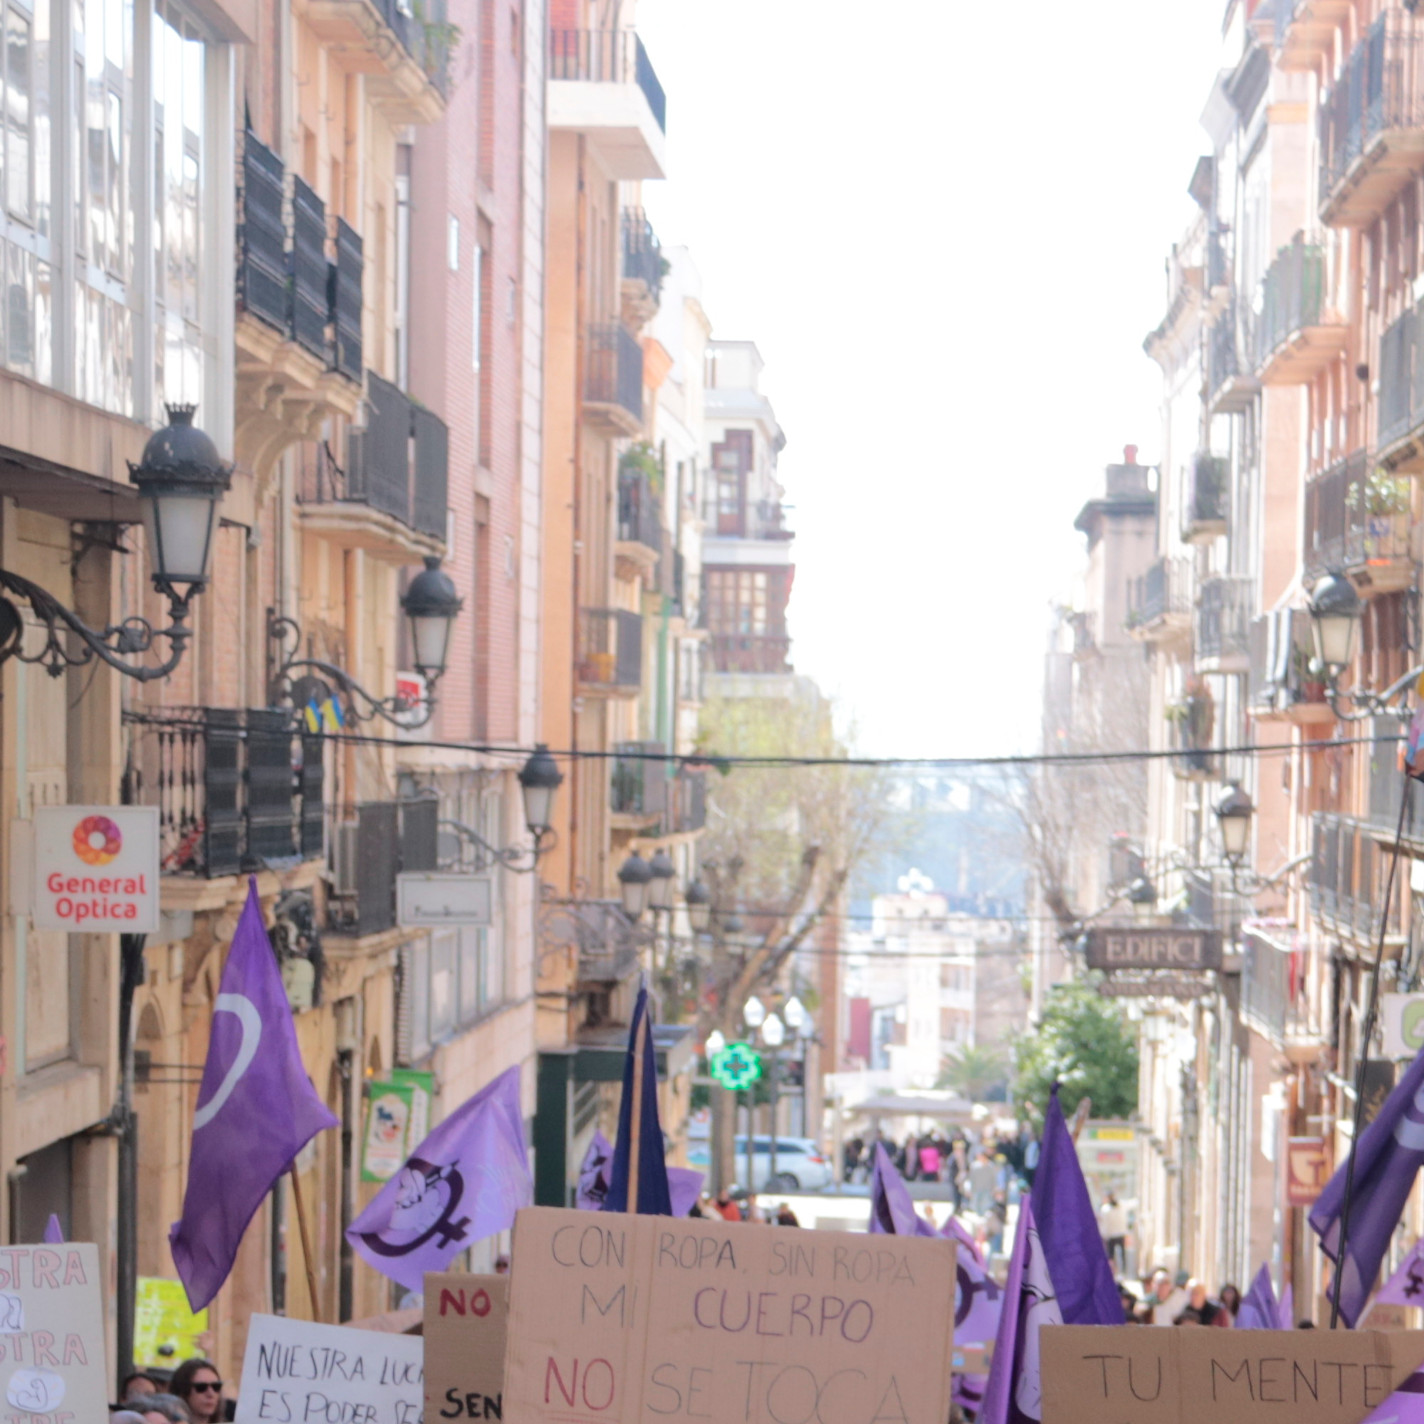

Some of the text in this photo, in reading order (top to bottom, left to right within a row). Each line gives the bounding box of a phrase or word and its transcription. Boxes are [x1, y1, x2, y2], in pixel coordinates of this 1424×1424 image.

[47, 872, 147, 895] General
[56, 897, 138, 924] Optica
[1106, 935, 1202, 962] EDIFICI
[551, 1224, 625, 1270] CON
[769, 1241, 815, 1281] SIN
[831, 1246, 916, 1288] ROPA
[438, 1287, 492, 1318] NO
[580, 1283, 875, 1344] MI CUERPO
[257, 1340, 366, 1382] NUESTRA
[543, 1356, 616, 1412] NO
[646, 1362, 714, 1419] SE
[1081, 1354, 1396, 1409] TU MENTE
[258, 1389, 292, 1424] ES
